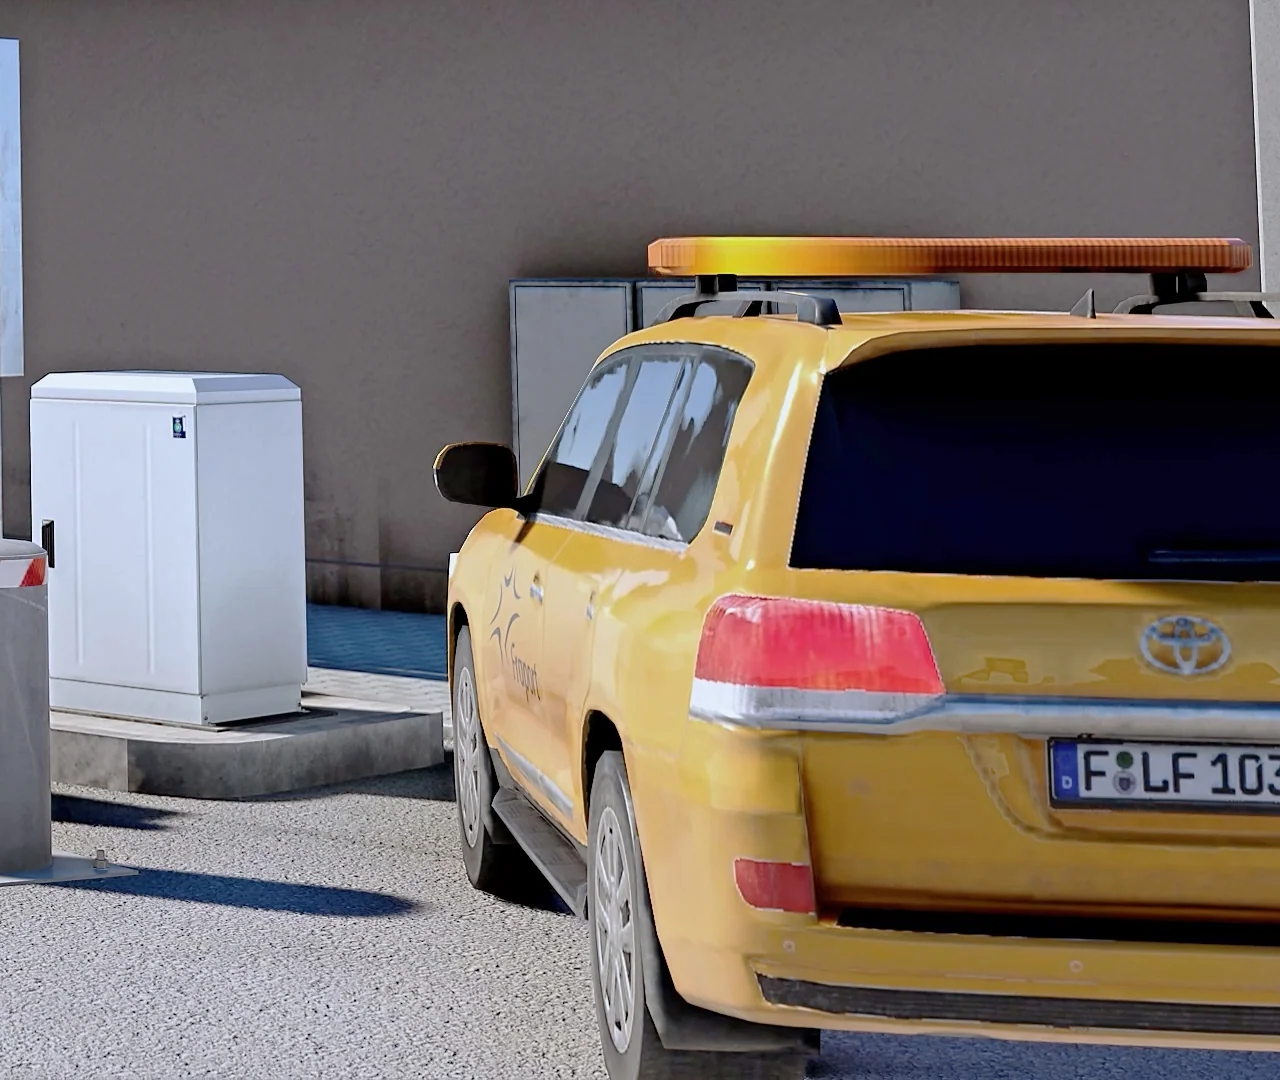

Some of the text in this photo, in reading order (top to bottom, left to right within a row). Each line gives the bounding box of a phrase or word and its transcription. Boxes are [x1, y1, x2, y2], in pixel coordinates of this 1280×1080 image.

[510, 642, 541, 703] Fraport
[1061, 775, 1073, 790] D
[1083, 750, 1110, 791] F
[1141, 751, 1198, 794] LF
